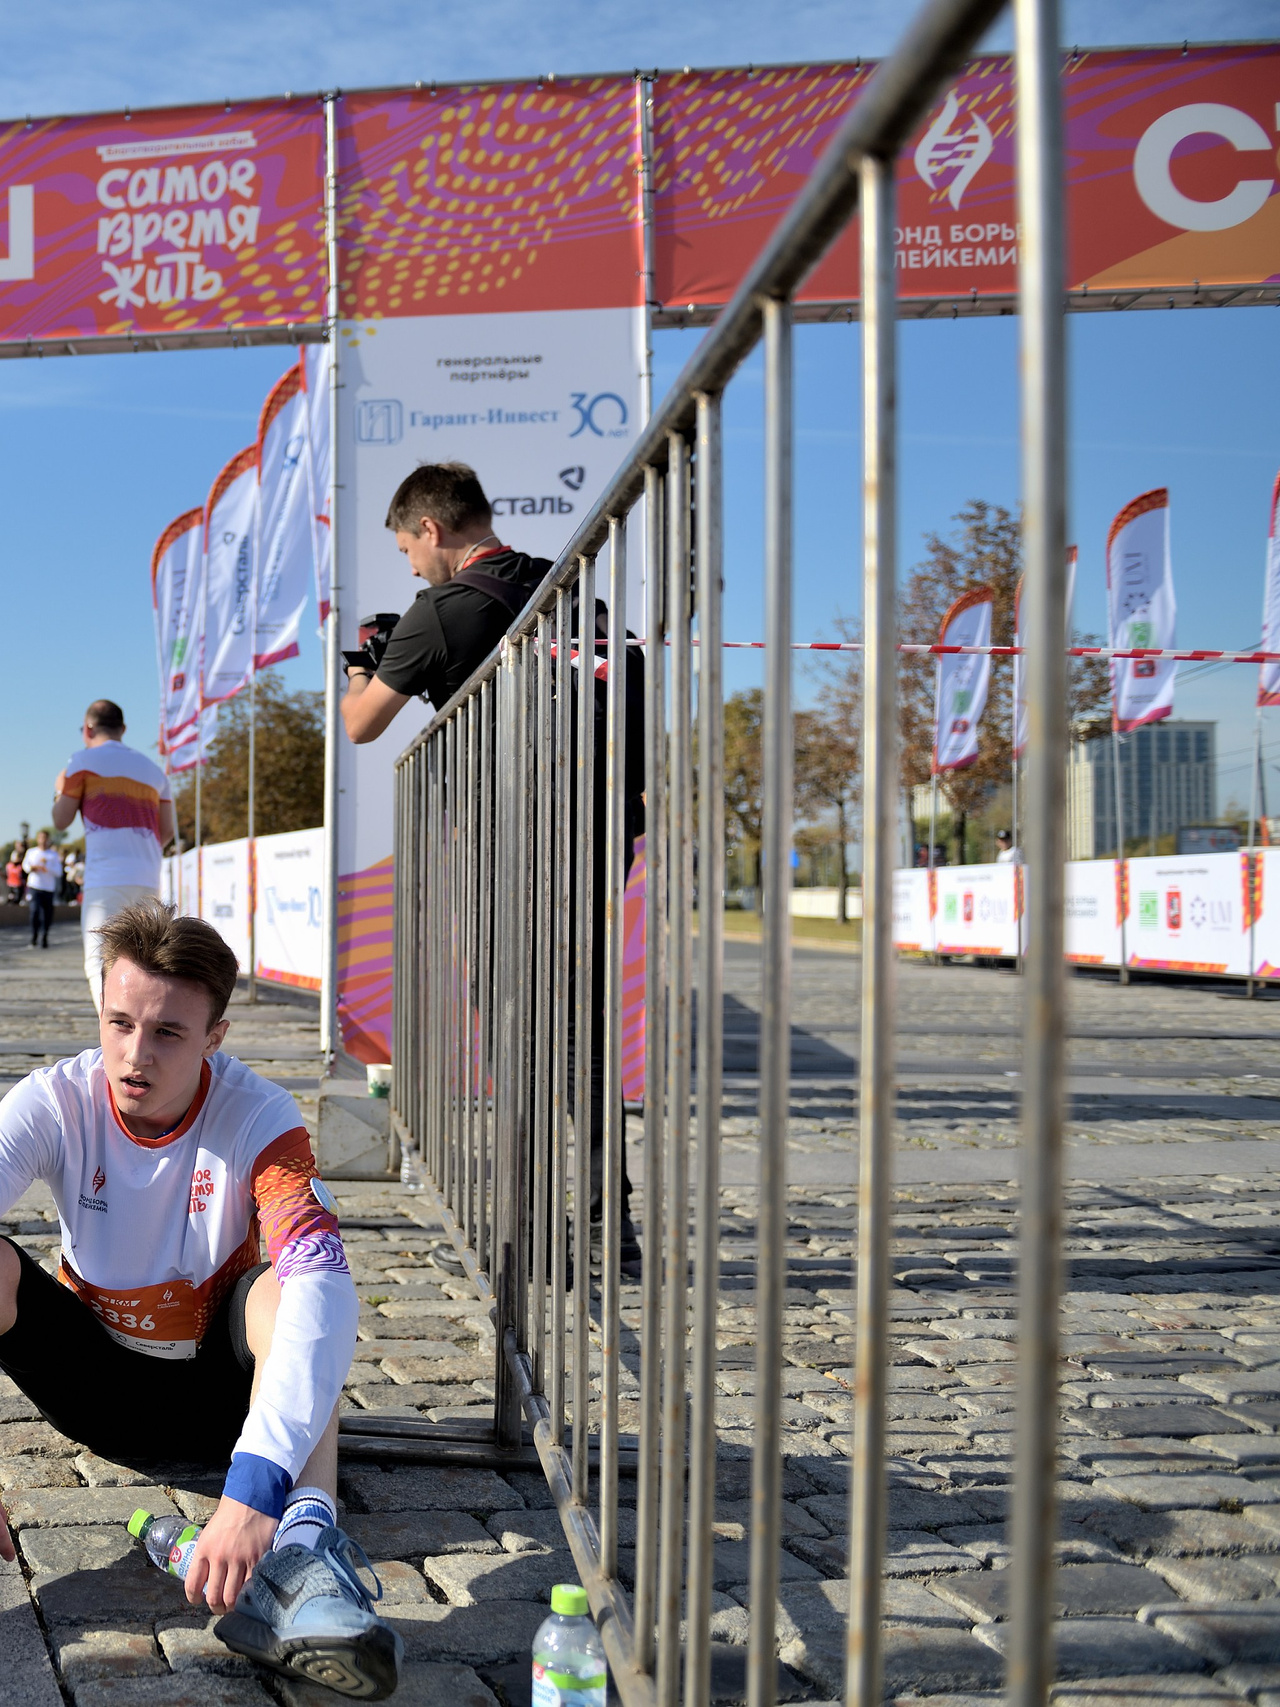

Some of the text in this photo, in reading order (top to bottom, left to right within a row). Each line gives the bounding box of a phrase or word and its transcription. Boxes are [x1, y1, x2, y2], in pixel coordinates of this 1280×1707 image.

[1133, 102, 1280, 232] С
[893, 222, 1024, 248] ОНД БОРЬ
[893, 245, 1024, 270] ЛЕЙКЕМИ
[437, 354, 543, 369] генеральные
[450, 367, 530, 383] партнёры
[409, 391, 629, 438] Гарант-Инвест 30
[491, 495, 574, 517] сталь
[90, 1299, 156, 1331] 2336
